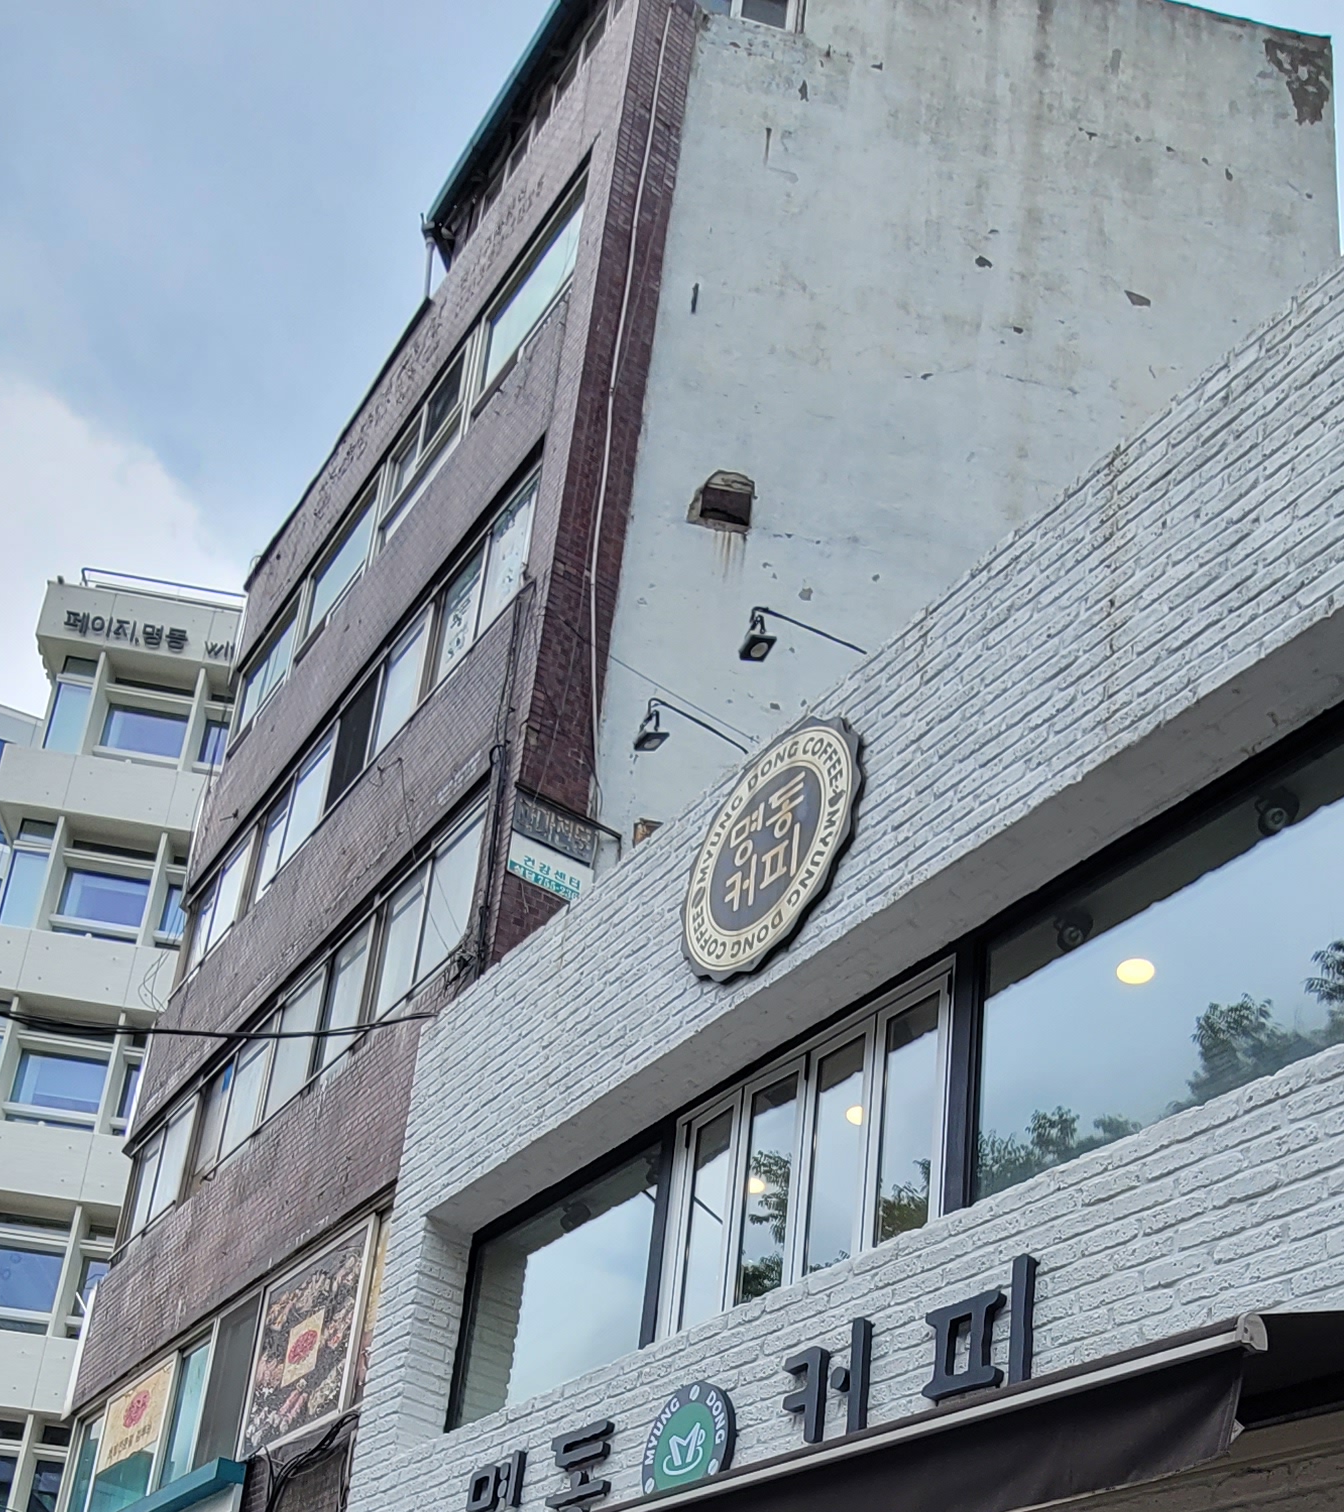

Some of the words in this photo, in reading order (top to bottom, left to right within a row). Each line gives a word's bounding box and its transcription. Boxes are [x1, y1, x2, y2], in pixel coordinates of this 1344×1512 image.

[697, 797, 744, 886] MYUNG
[746, 740, 801, 793] DONG
[802, 737, 844, 788] COFFEE
[729, 771, 806, 867] 명동
[786, 806, 841, 908] MYUNG
[724, 821, 801, 912] 커피
[692, 911, 728, 960] COFFEE
[730, 910, 784, 960] DONG
[782, 1253, 1042, 1444] 커피
[643, 1397, 681, 1467] MYUNG
[705, 1388, 727, 1447] DONG
